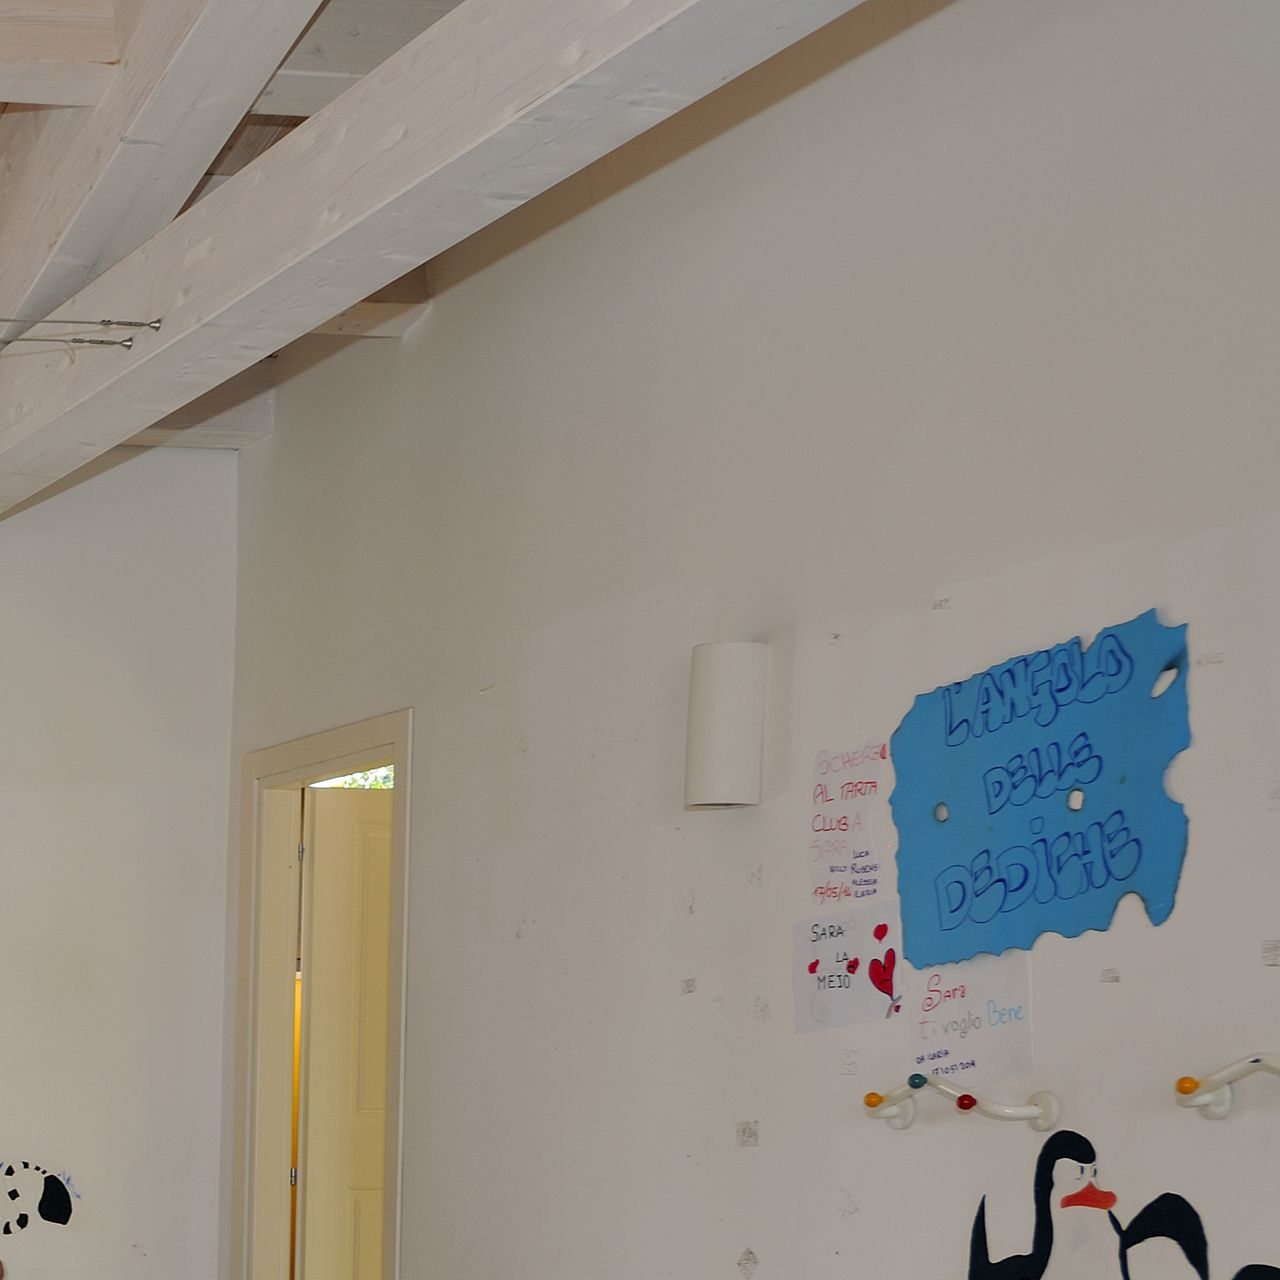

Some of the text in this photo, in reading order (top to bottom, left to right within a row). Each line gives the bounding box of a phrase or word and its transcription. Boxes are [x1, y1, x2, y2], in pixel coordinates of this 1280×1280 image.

[942, 633, 1134, 747] L'ANGOLO
[982, 732, 1103, 815] DELLE
[813, 781, 878, 805] AL TARTA
[811, 814, 848, 832] CLUB
[810, 924, 845, 942] SARA
[836, 952, 849, 963] LA
[942, 1010, 981, 1039] voglio
